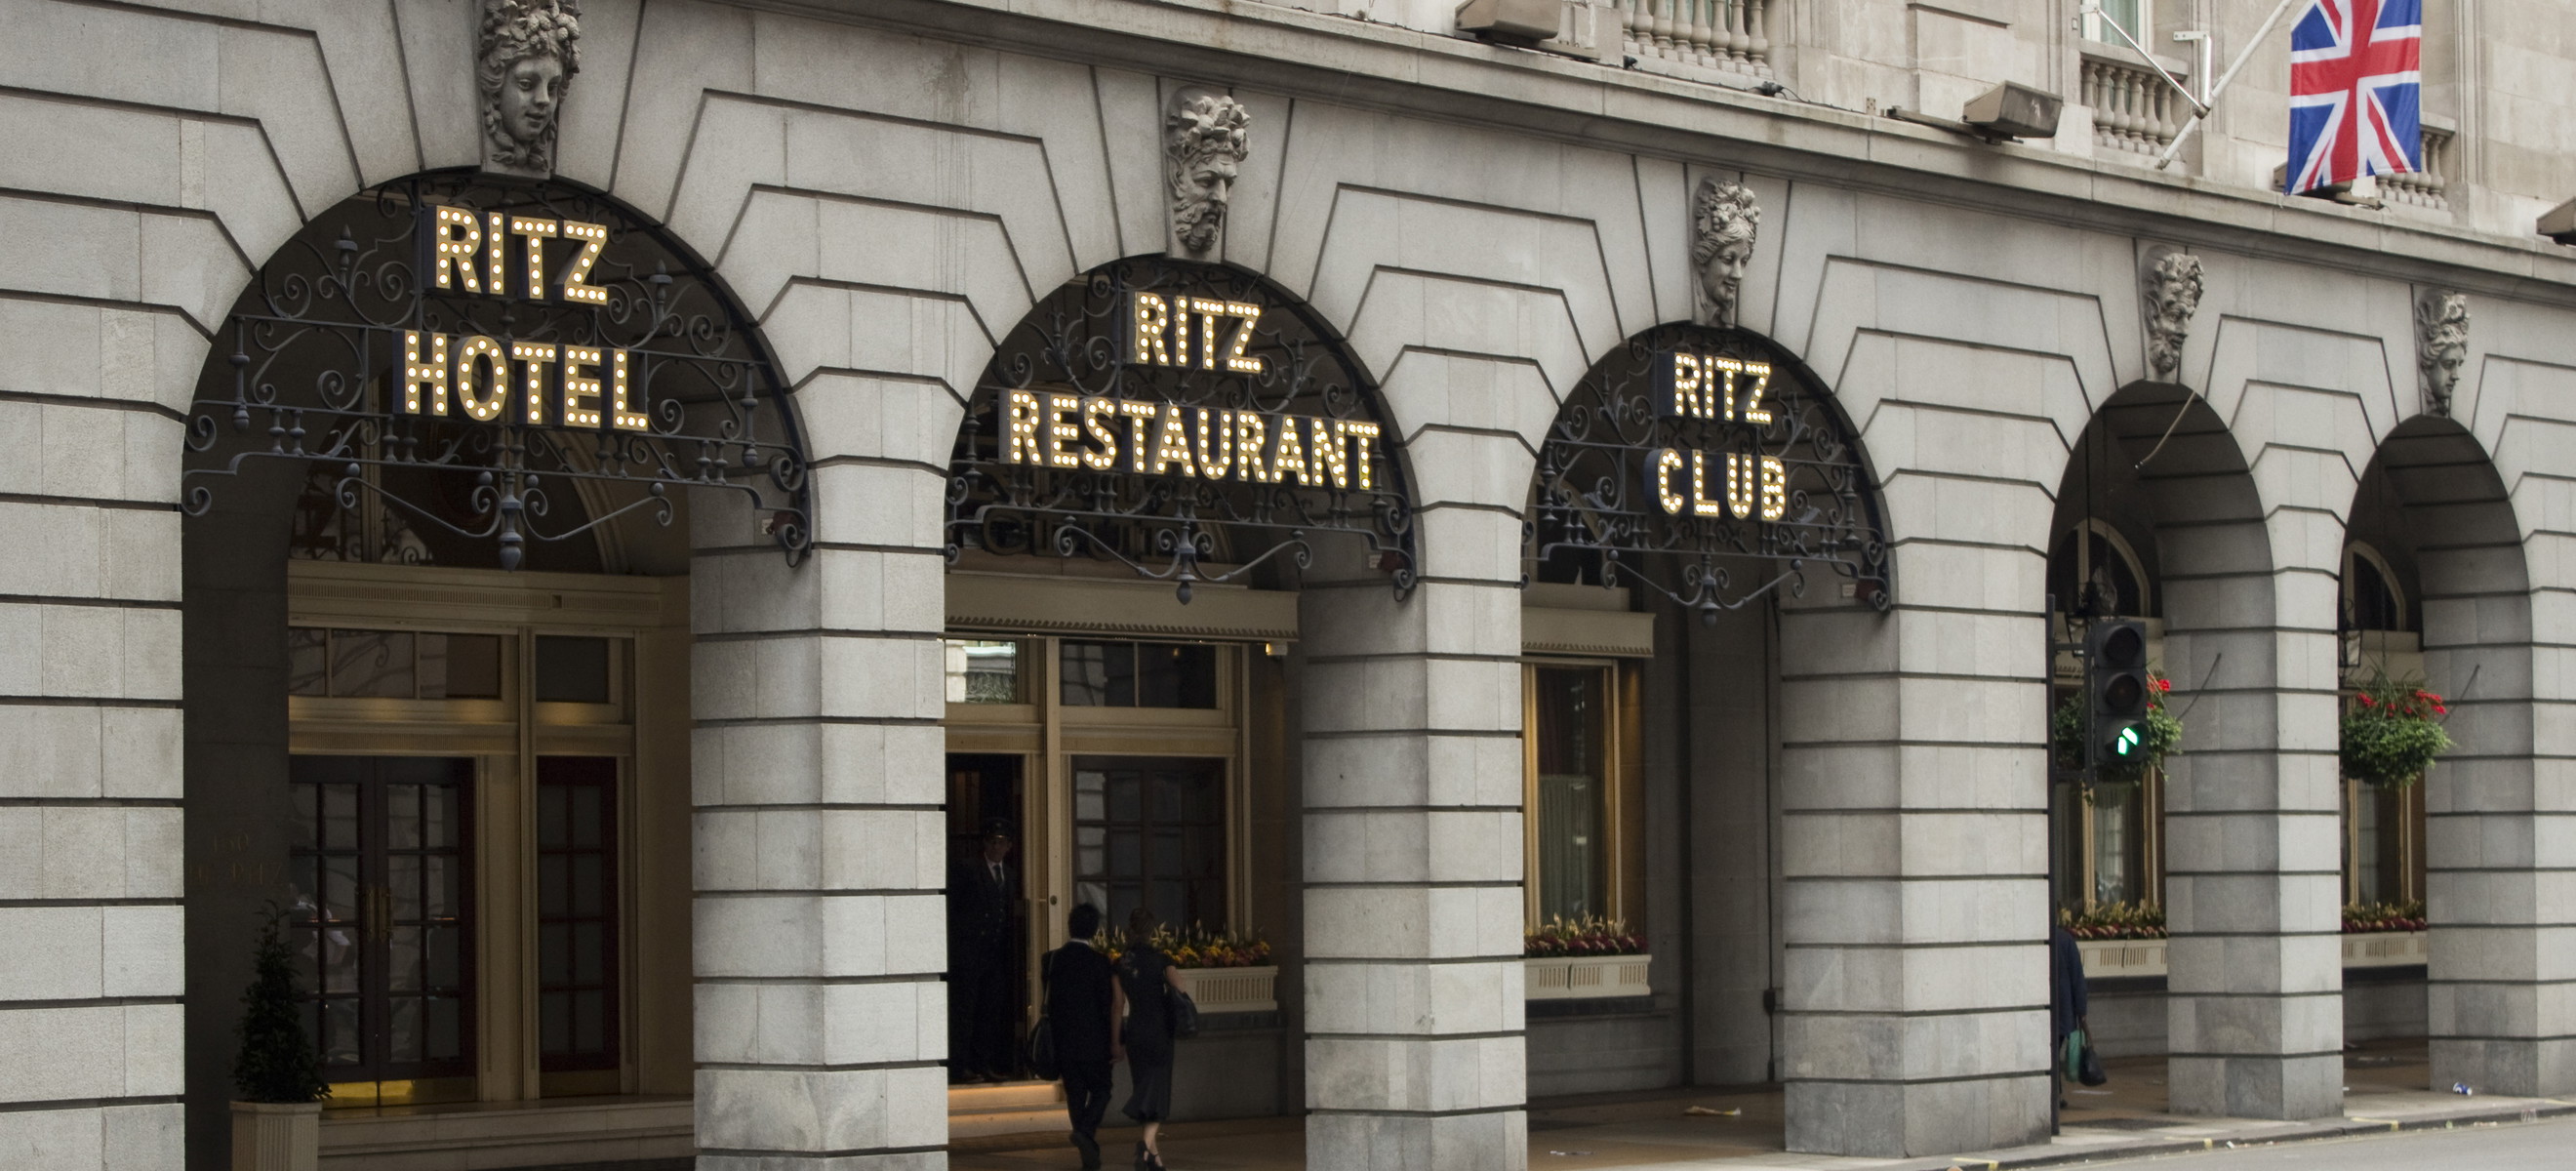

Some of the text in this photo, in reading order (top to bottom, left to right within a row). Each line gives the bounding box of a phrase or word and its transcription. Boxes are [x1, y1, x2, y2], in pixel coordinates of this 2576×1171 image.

[436, 205, 608, 305] RITZ
[1135, 292, 1261, 373] RITZ
[404, 330, 648, 431] HOTEL
[1674, 352, 1771, 424] RITZ
[1009, 388, 1381, 490] RESTAURANT
[1659, 448, 1786, 522] CLUB
